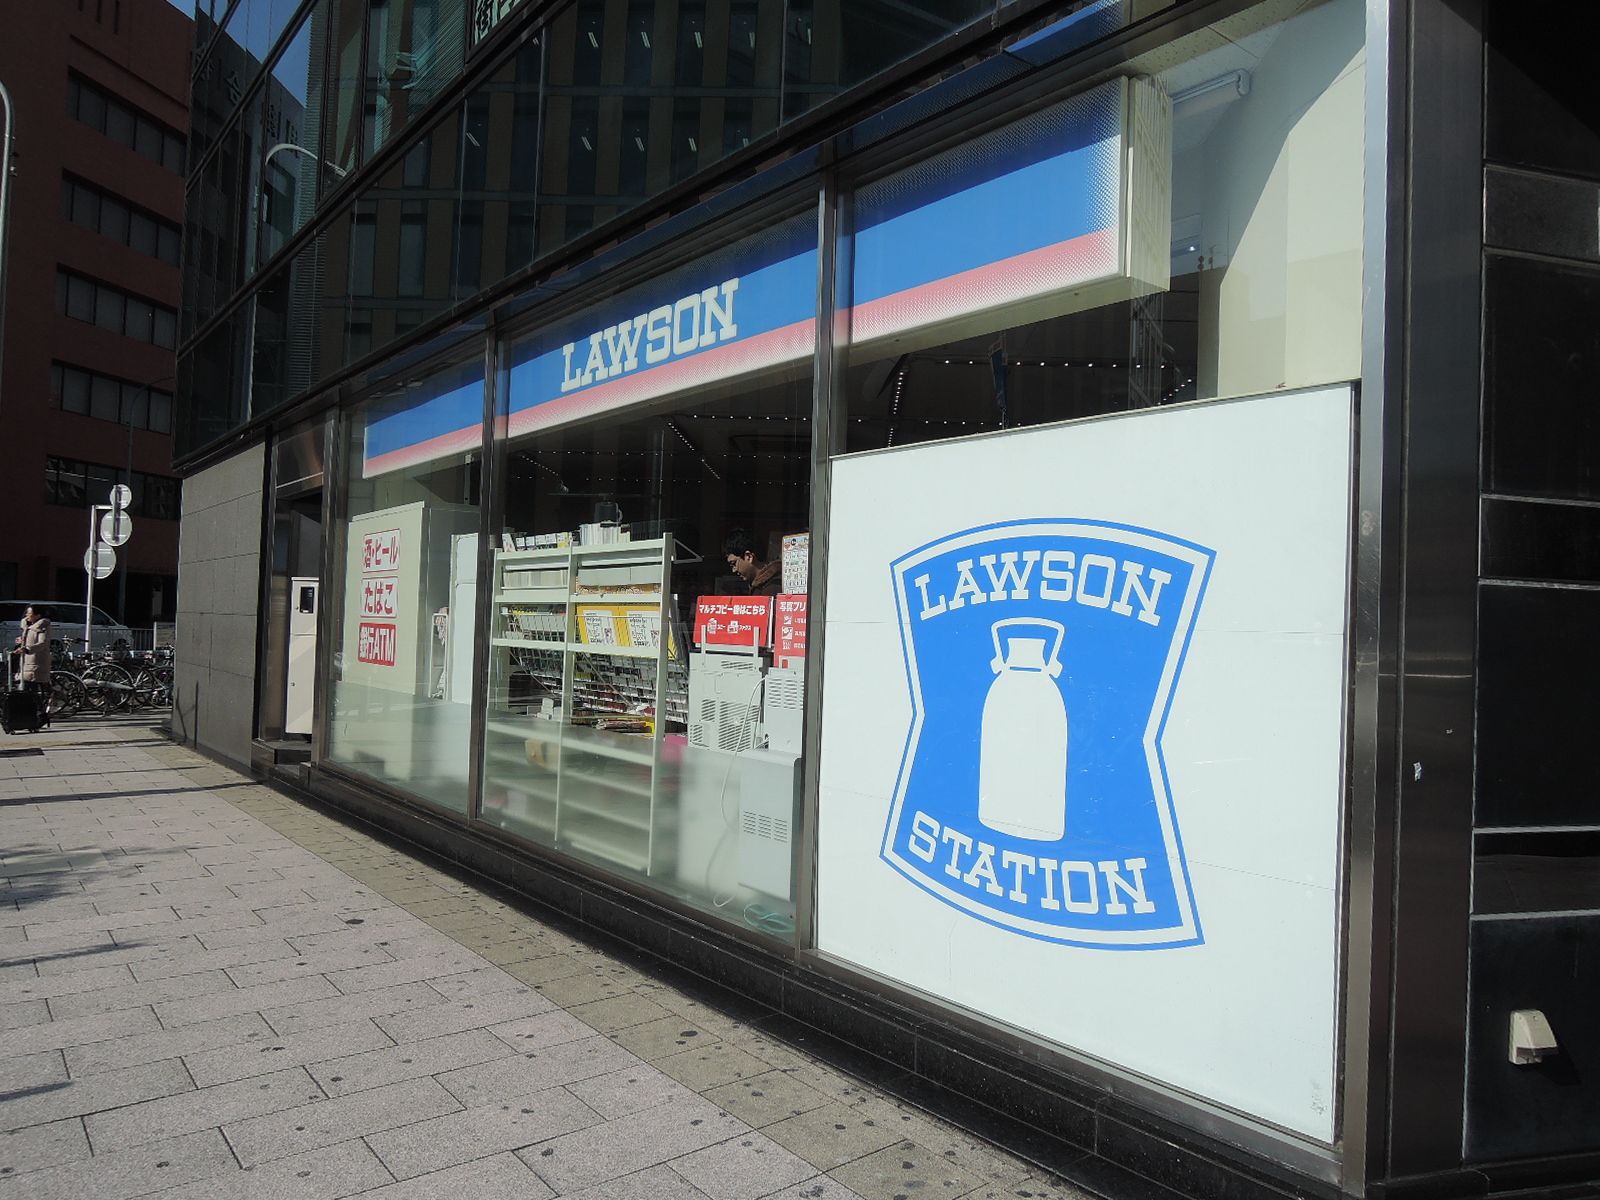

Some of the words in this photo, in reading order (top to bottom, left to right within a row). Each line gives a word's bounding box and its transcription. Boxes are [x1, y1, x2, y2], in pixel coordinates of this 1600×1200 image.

[561, 277, 739, 392] LAWSON
[365, 581, 393, 614] たばこ
[915, 550, 1172, 626] LAWSON
[908, 811, 1155, 915] STATION
